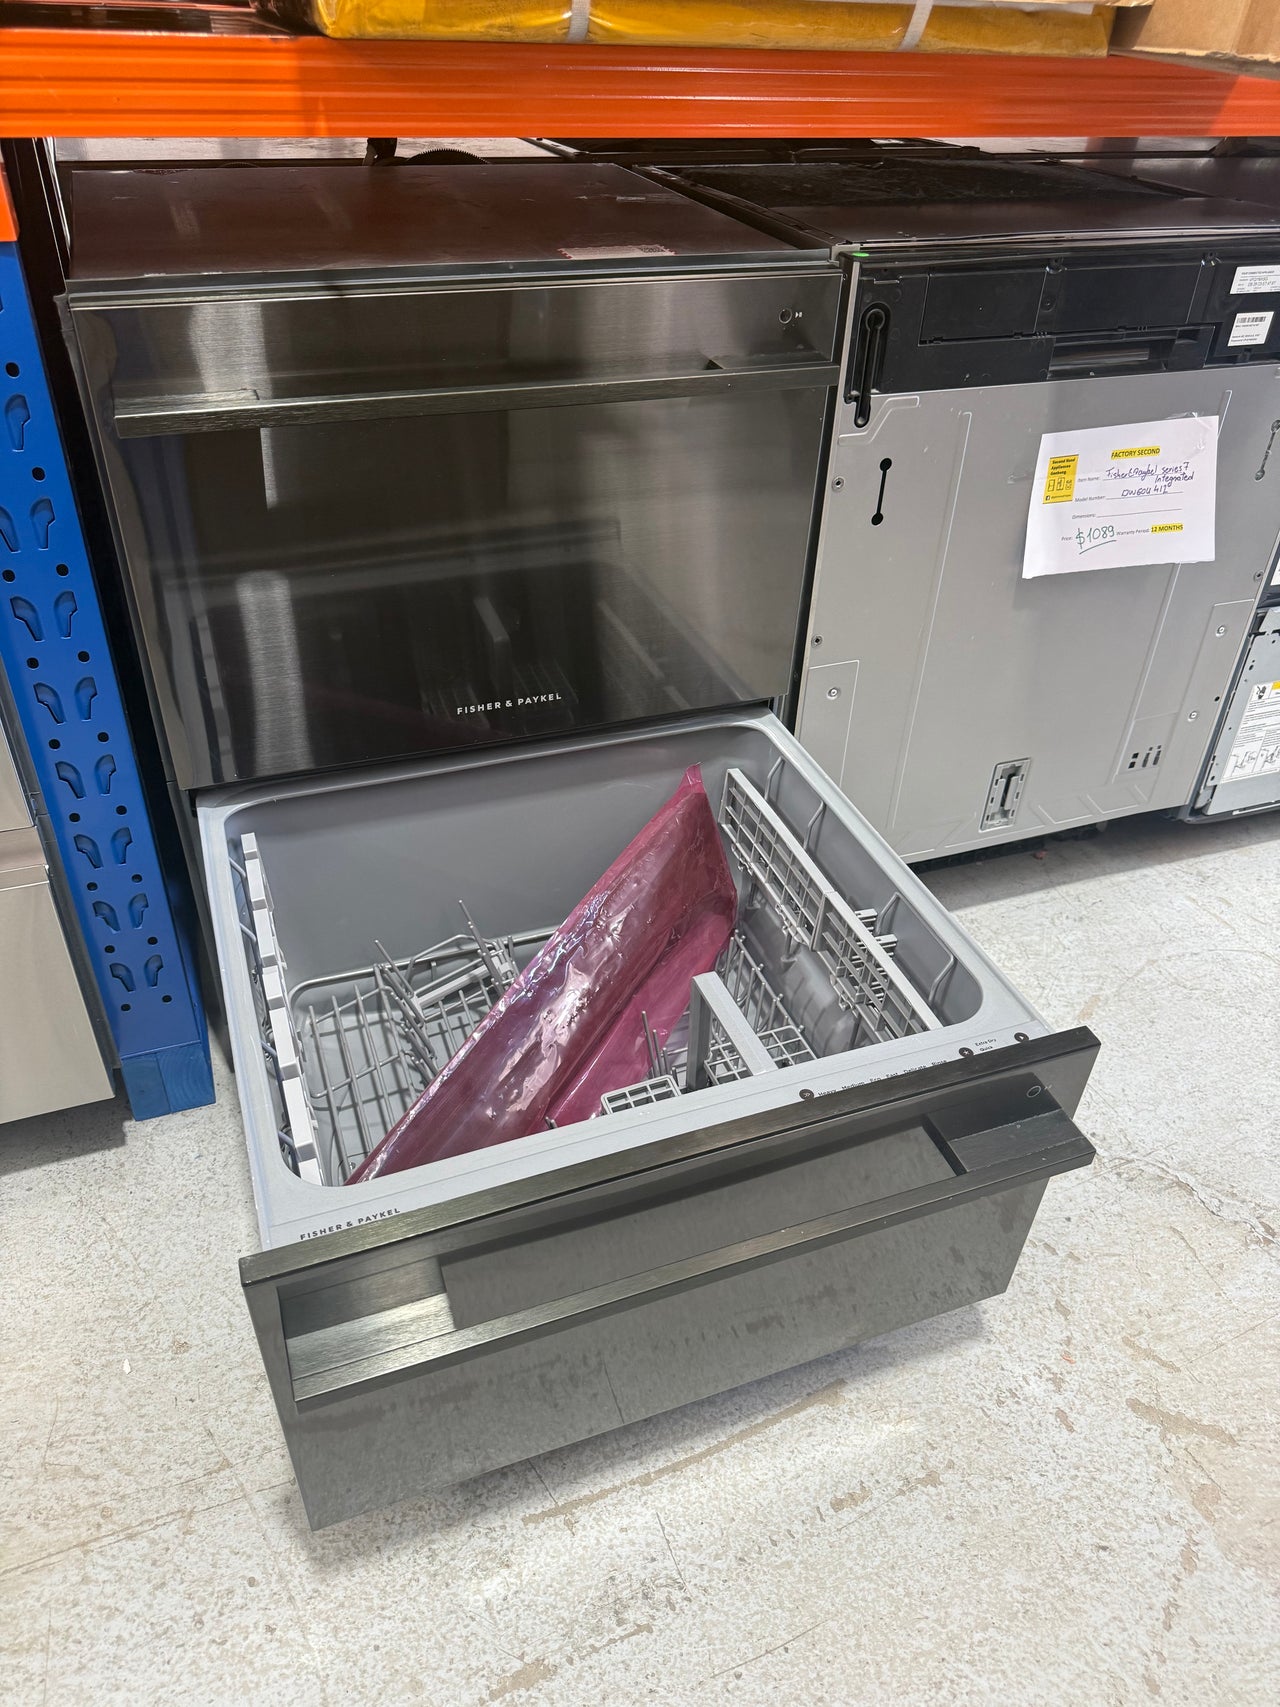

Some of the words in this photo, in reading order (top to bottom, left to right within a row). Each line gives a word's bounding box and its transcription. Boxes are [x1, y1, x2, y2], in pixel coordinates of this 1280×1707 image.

[1111, 450, 1136, 458] FACTORY
[1137, 448, 1160, 456] SECOND
[1075, 525, 1115, 549] $1089
[1158, 524, 1183, 532] MONTHS
[457, 701, 501, 715] FISHER
[517, 692, 562, 706] PAYKEL
[300, 1224, 342, 1240] FISHER
[357, 1208, 401, 1224] PAYKEL
